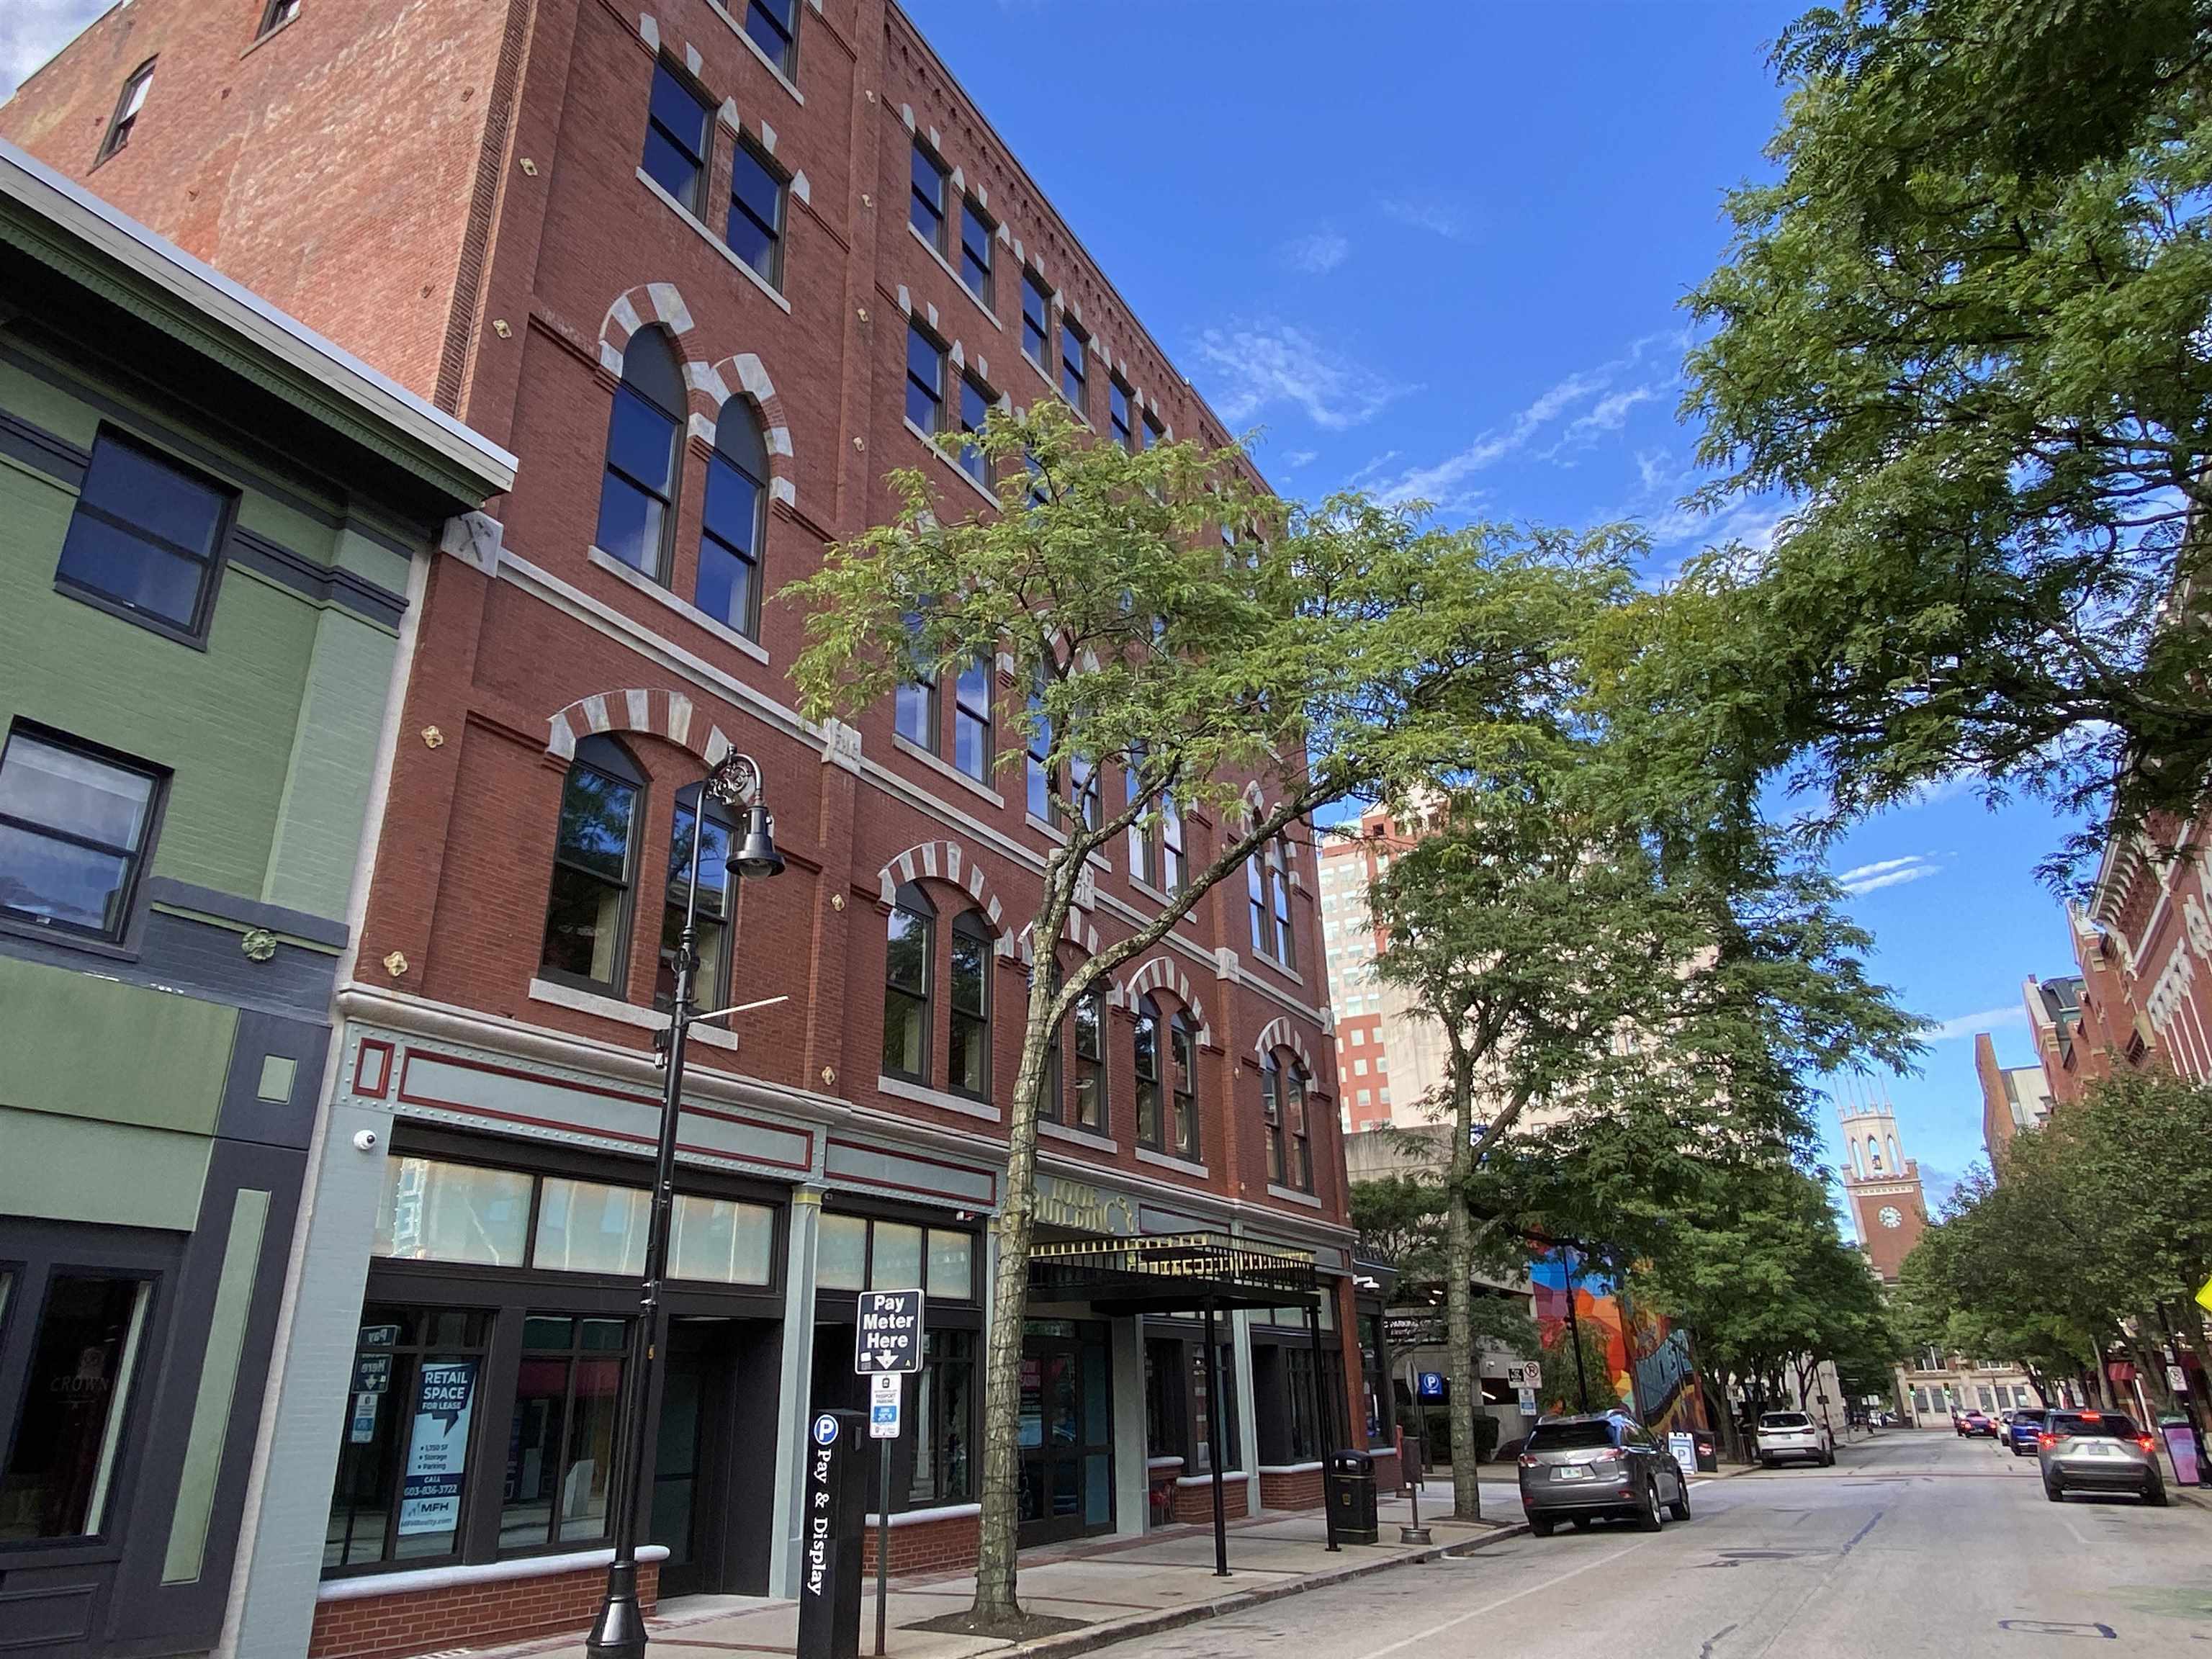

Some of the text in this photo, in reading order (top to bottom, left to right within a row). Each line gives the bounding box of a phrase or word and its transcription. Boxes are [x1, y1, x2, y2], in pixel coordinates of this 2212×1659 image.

[873, 1295, 904, 1313] Pay
[863, 1313, 914, 1330] Meter
[867, 1333, 909, 1349] Here
[425, 1371, 468, 1384] RETAIL
[423, 1386, 465, 1400] SPACE
[422, 1401, 462, 1410] FOR LEASE
[421, 1502, 449, 1513] MFH
[807, 1449, 832, 1596] Pay & Display
